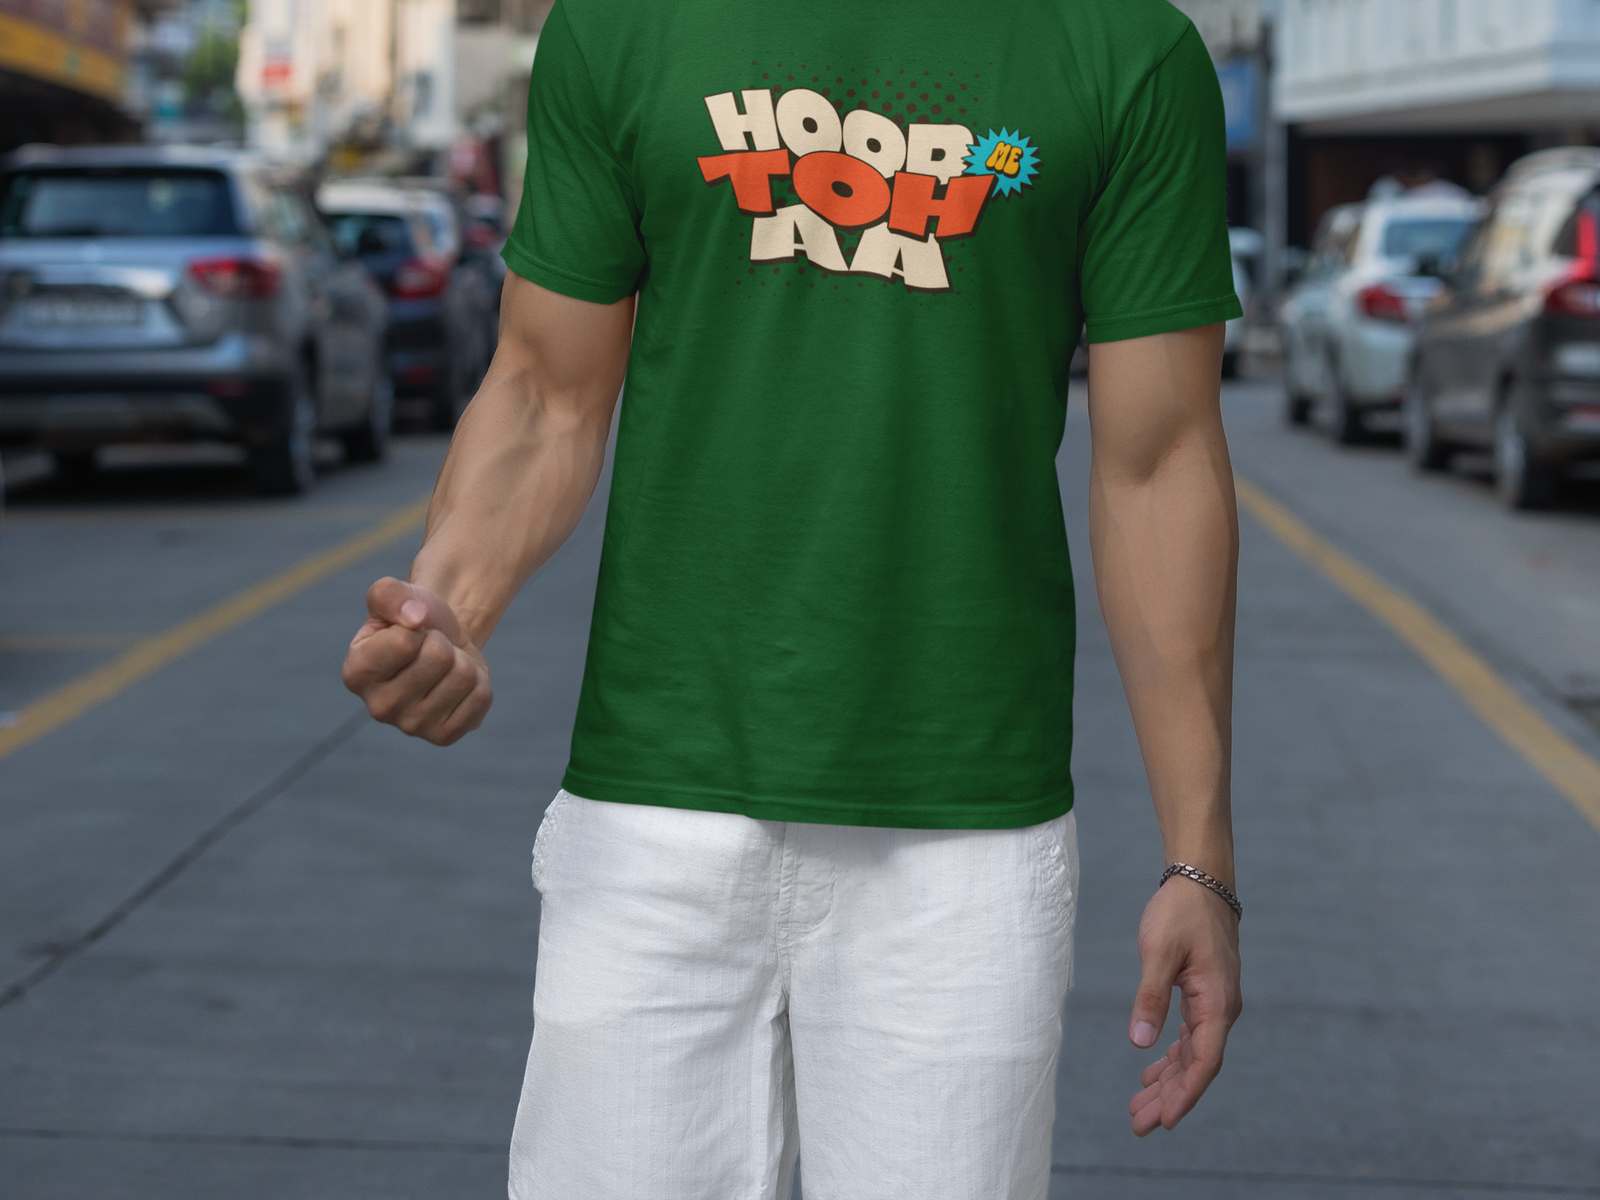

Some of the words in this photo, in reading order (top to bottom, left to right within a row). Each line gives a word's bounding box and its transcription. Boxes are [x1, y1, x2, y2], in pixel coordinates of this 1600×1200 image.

[696, 149, 995, 238] TOH
[985, 141, 1023, 178] ME
[749, 203, 950, 289] AA
